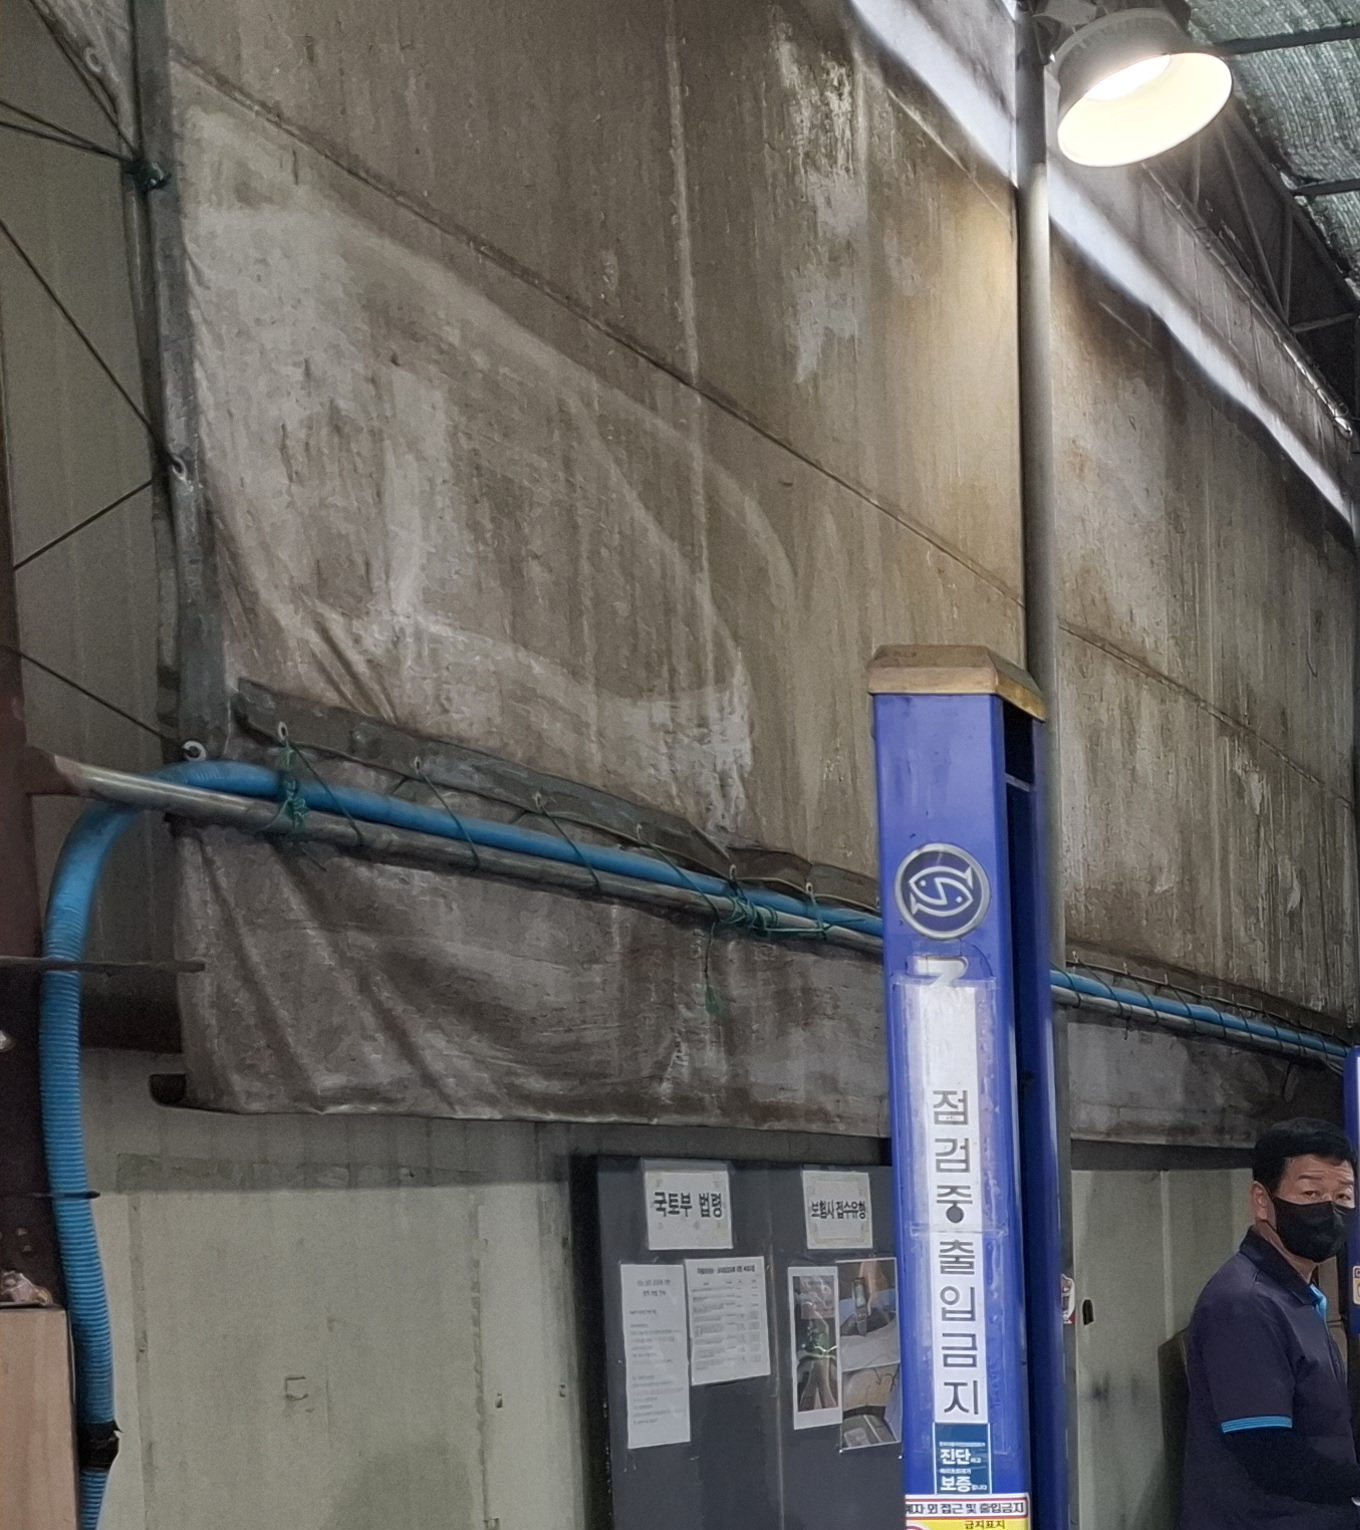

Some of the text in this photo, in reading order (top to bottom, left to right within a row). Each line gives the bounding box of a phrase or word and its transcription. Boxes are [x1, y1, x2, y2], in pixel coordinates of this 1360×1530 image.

[654, 1192, 693, 1217] 국토부
[933, 1089, 973, 1224] 점검중
[938, 1239, 979, 1415] 출입금지
